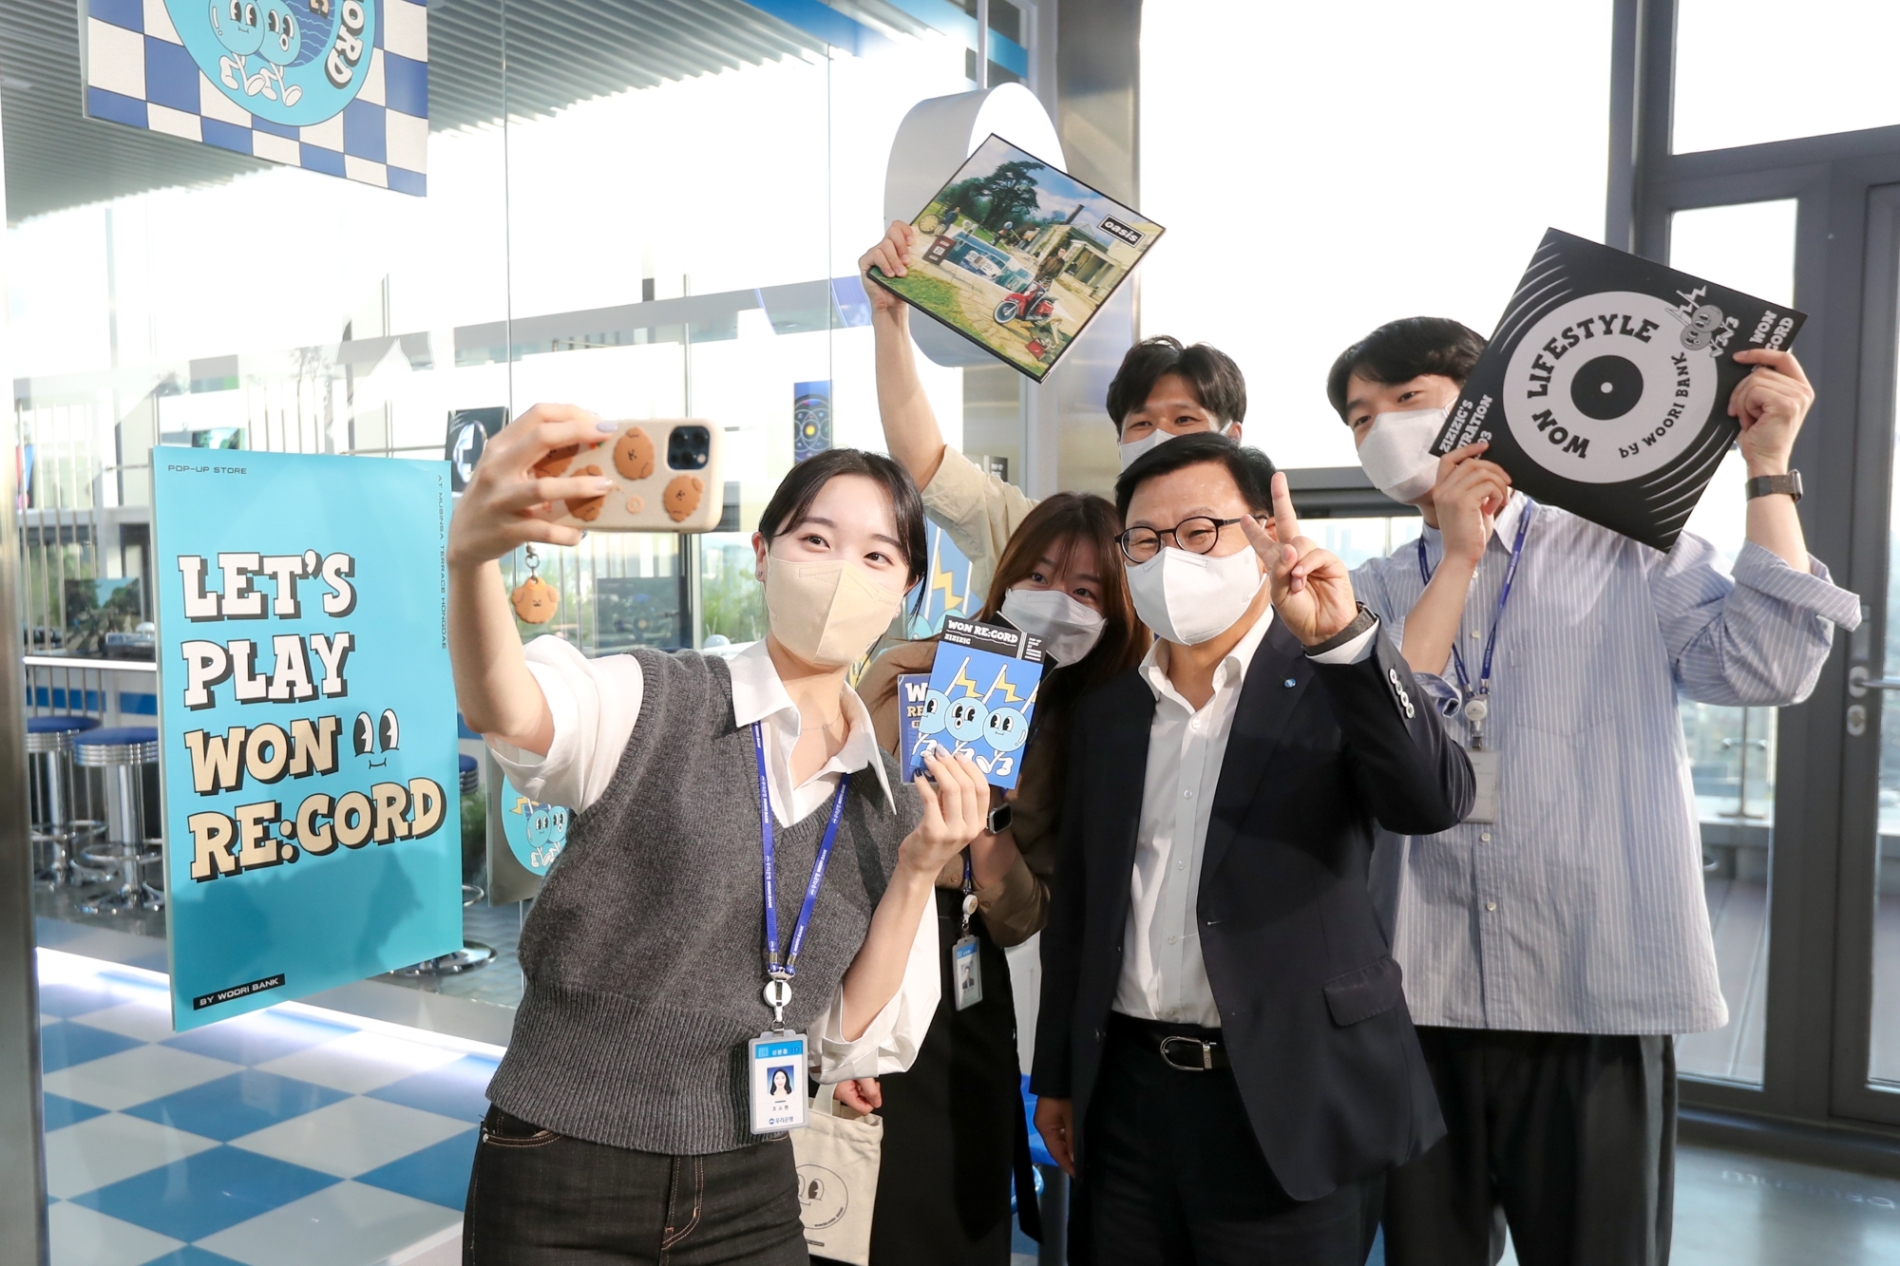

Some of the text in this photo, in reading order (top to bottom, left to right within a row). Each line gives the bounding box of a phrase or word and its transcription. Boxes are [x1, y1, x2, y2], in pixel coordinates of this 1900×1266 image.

[325, 0, 364, 89] ORD
[1104, 220, 1139, 243] oasis
[1749, 310, 1778, 343] WON
[1457, 394, 1493, 449] URATION
[1527, 313, 1660, 459] WON LIFESTYLE
[1618, 352, 1691, 458] by WOORI BANK
[168, 464, 247, 475] POP-UP STORE
[177, 549, 356, 622] LET'S
[948, 619, 1018, 643] WON RE:CORD
[181, 631, 355, 711] PLAY
[184, 715, 342, 796] WON
[187, 777, 447, 883] RE:CORD
[199, 977, 279, 1006] BY WOORI BANK
